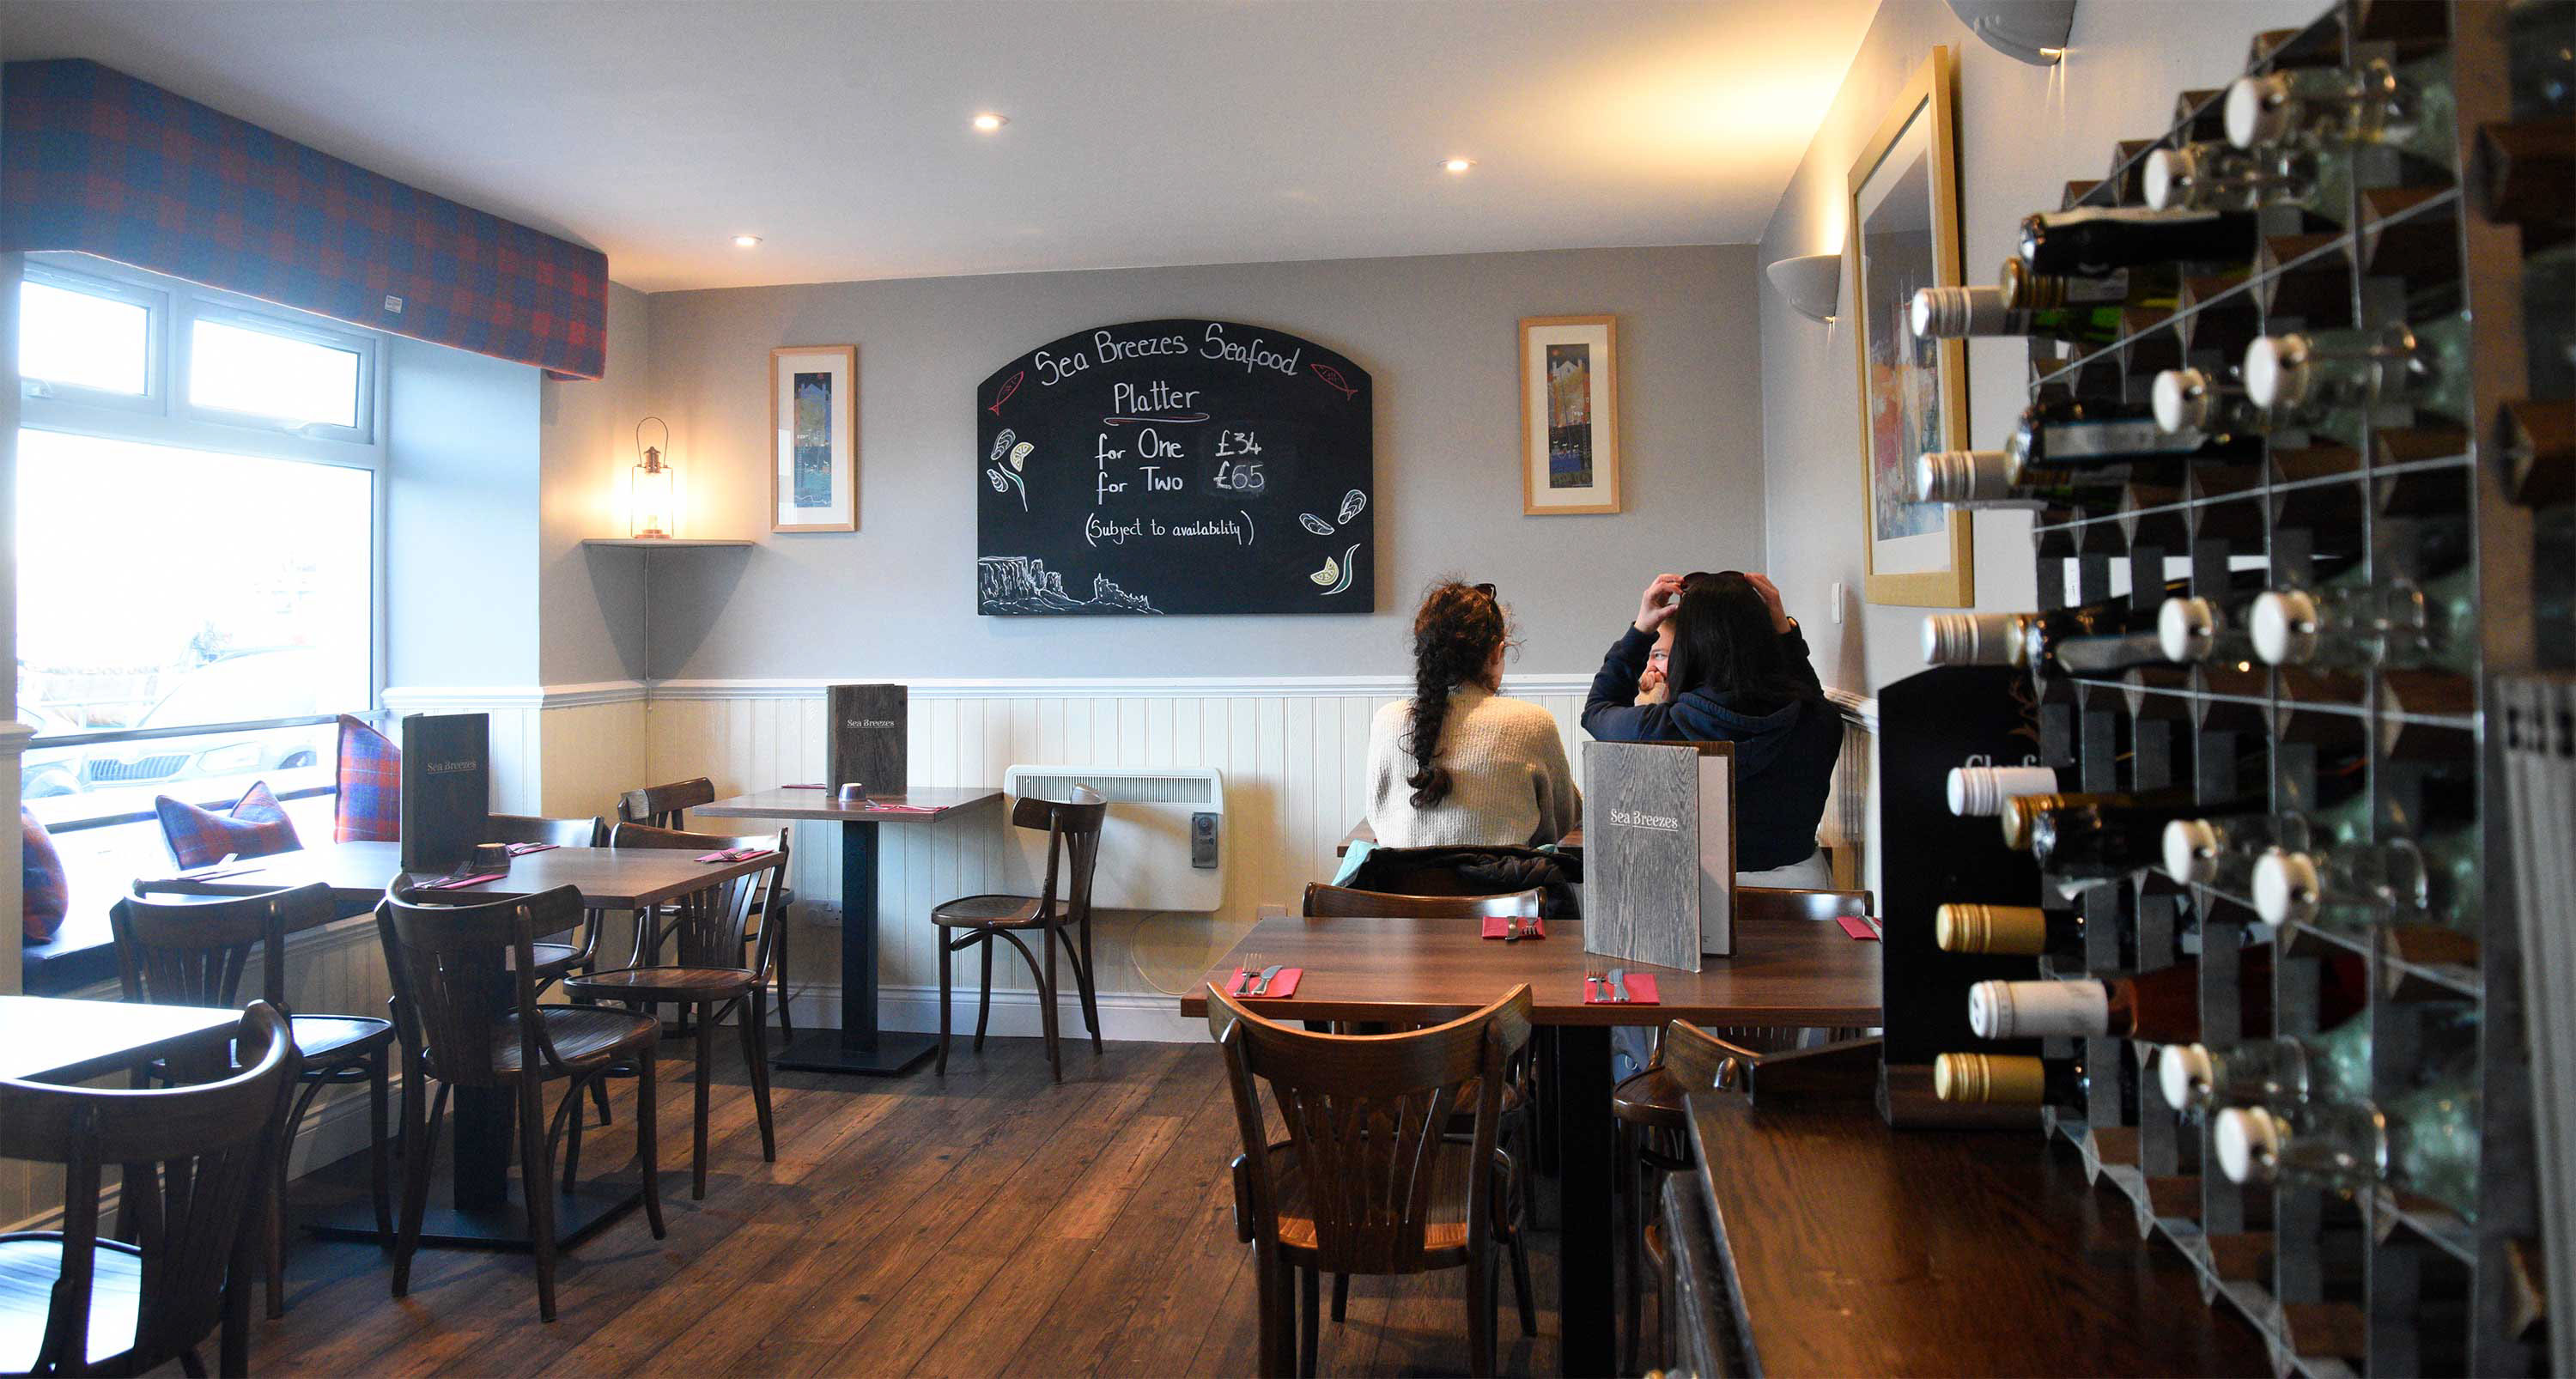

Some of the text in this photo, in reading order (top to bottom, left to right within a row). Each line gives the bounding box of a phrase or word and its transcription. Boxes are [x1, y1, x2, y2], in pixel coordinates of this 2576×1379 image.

[1035, 323, 1302, 386] Sea Breezes Seafood
[1113, 380, 1200, 415] Platter
[1095, 428, 1262, 470] for One £34
[1096, 460, 1265, 505] for Two £65
[1085, 510, 1255, 547] (Subject to availability)
[1610, 808, 1678, 829] Sea Breezes
